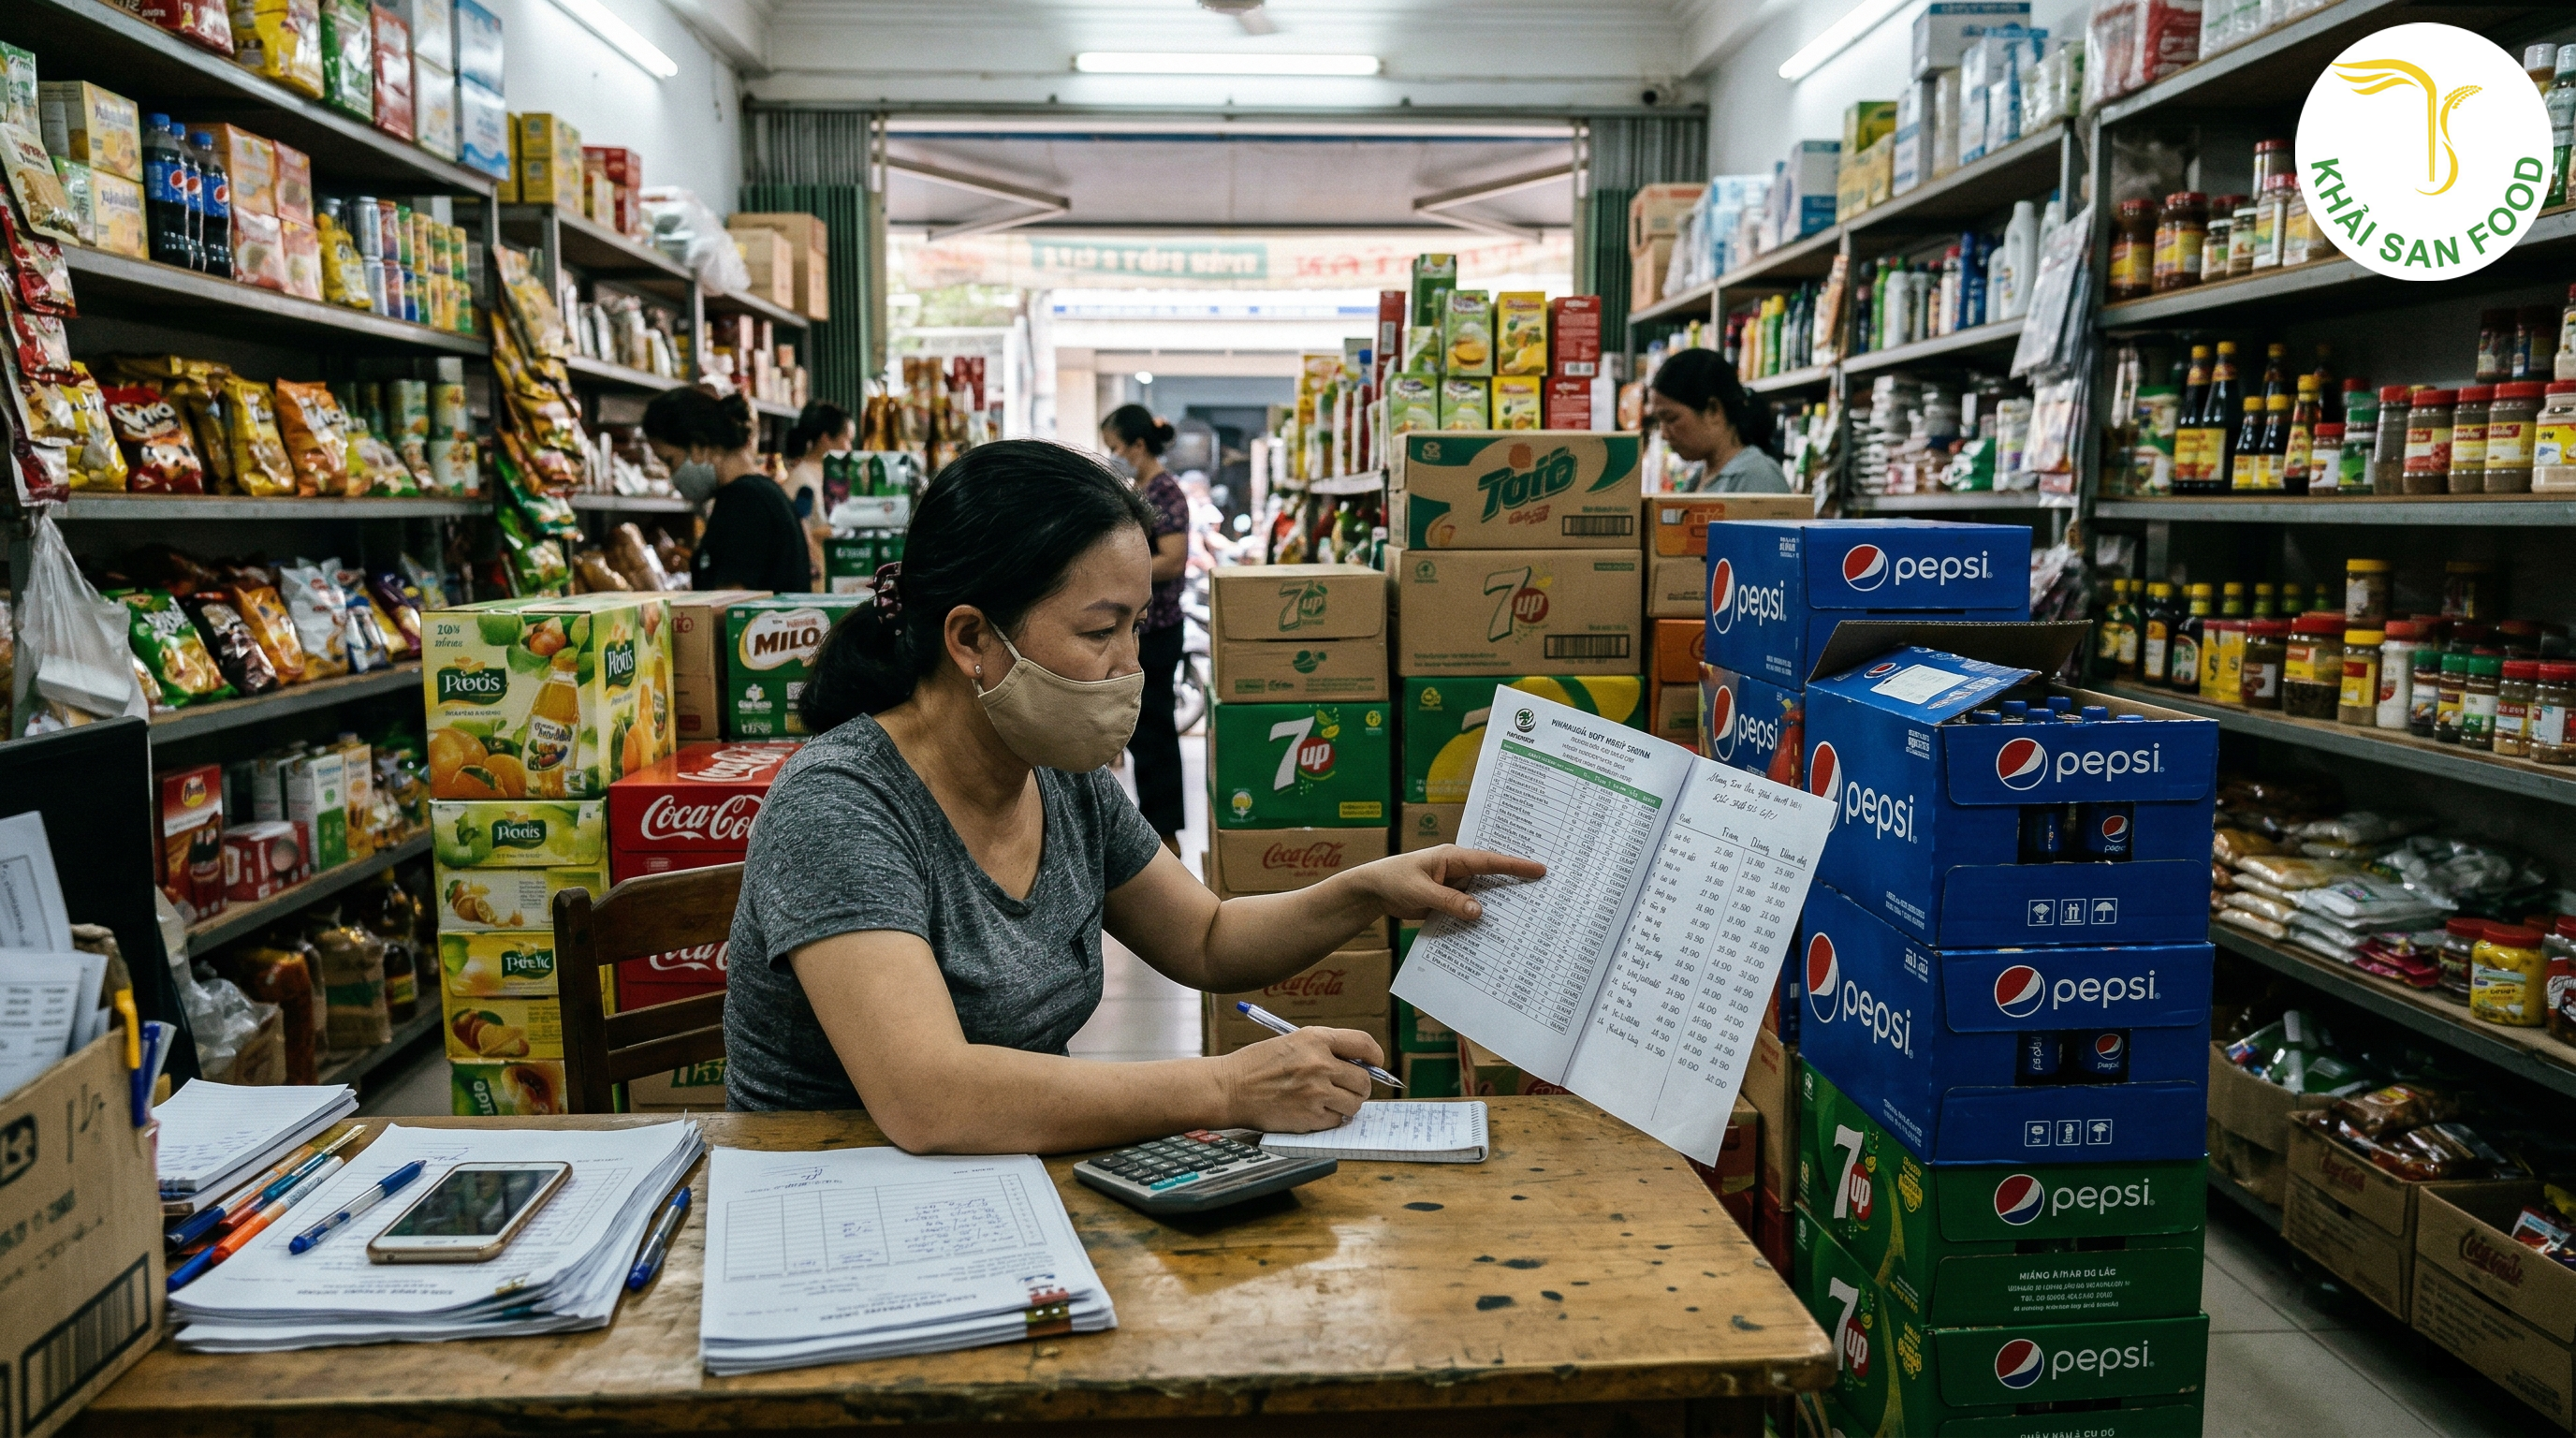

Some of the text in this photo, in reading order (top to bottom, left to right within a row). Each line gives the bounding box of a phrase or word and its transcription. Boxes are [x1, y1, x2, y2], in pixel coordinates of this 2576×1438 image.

[1895, 550, 1989, 586] pepsi
[1737, 580, 1785, 627] pepsi
[754, 626, 821, 657] MILO
[1738, 713, 1778, 756] pepsi
[2056, 742, 2162, 783] pepsi
[640, 794, 765, 841] Coca-Co
[1846, 781, 1916, 844] pepsi
[2054, 970, 2157, 1009] pepsi
[1843, 978, 1912, 1055] pepsi
[2052, 1178, 2152, 1217] pepsi
[2052, 1340, 2151, 1380] pepsi
